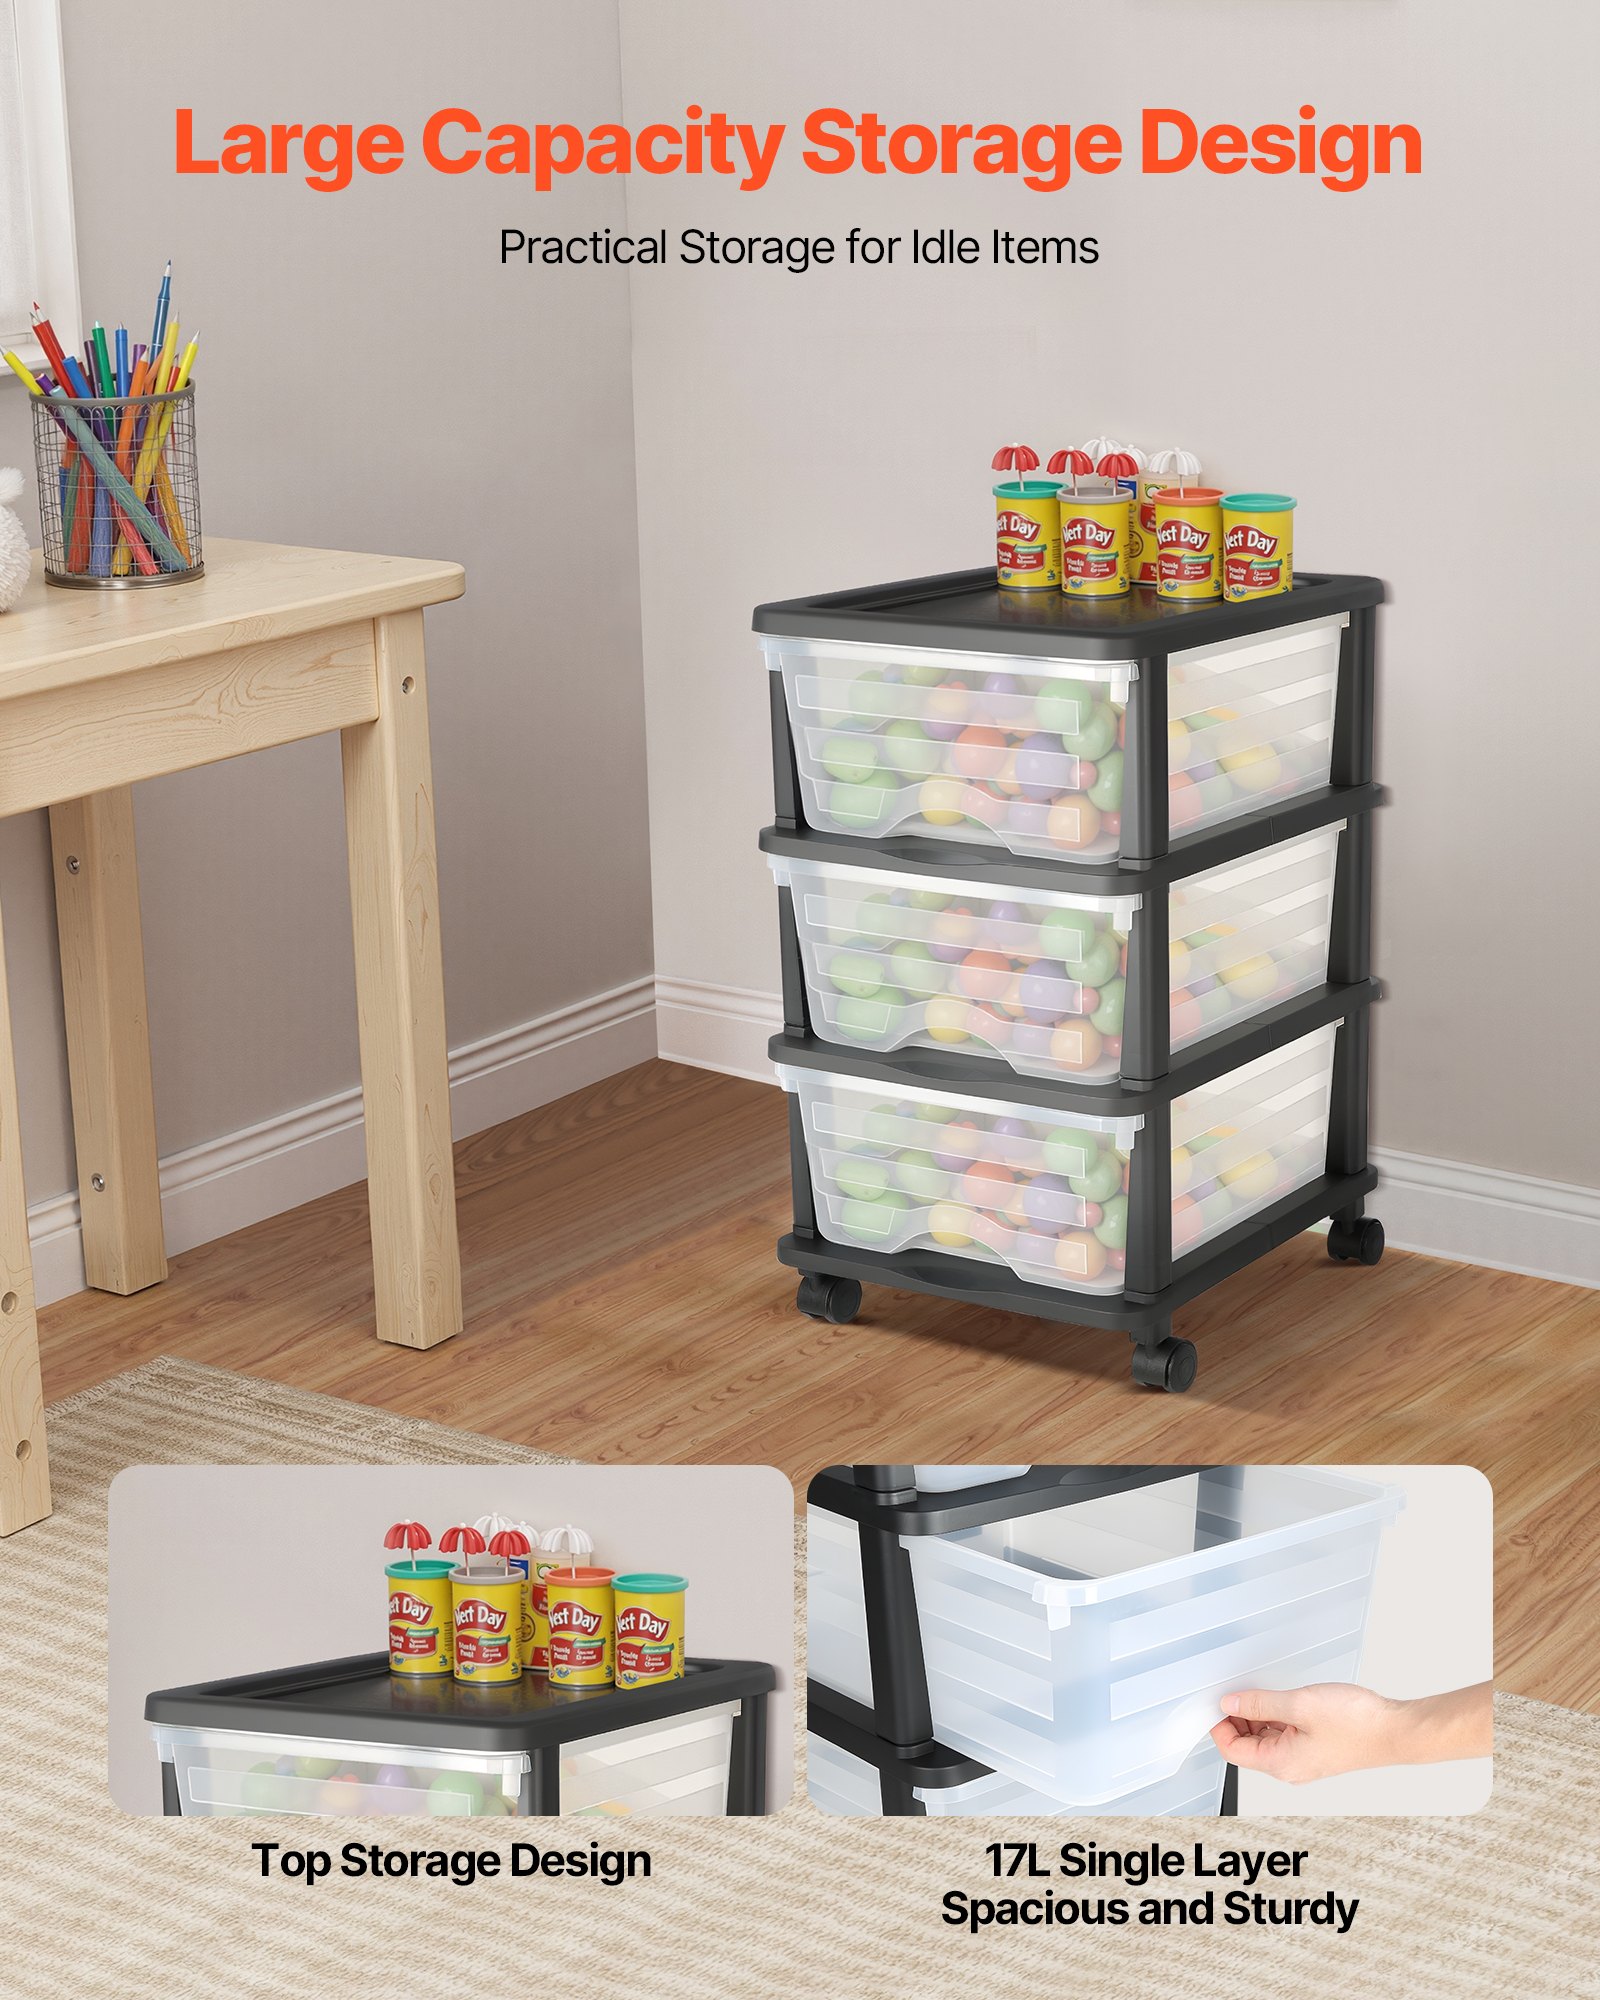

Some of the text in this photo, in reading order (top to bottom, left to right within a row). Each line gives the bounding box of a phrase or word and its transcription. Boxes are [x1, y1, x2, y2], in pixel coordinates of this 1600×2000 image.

[1010, 515, 1038, 539] Day
[1085, 523, 1113, 546] Day
[1179, 525, 1208, 549] Day
[1246, 530, 1276, 555] Day
[402, 1596, 430, 1622] Day
[477, 1605, 505, 1630] Day
[571, 1607, 600, 1633] Day
[638, 1612, 667, 1639] Day
